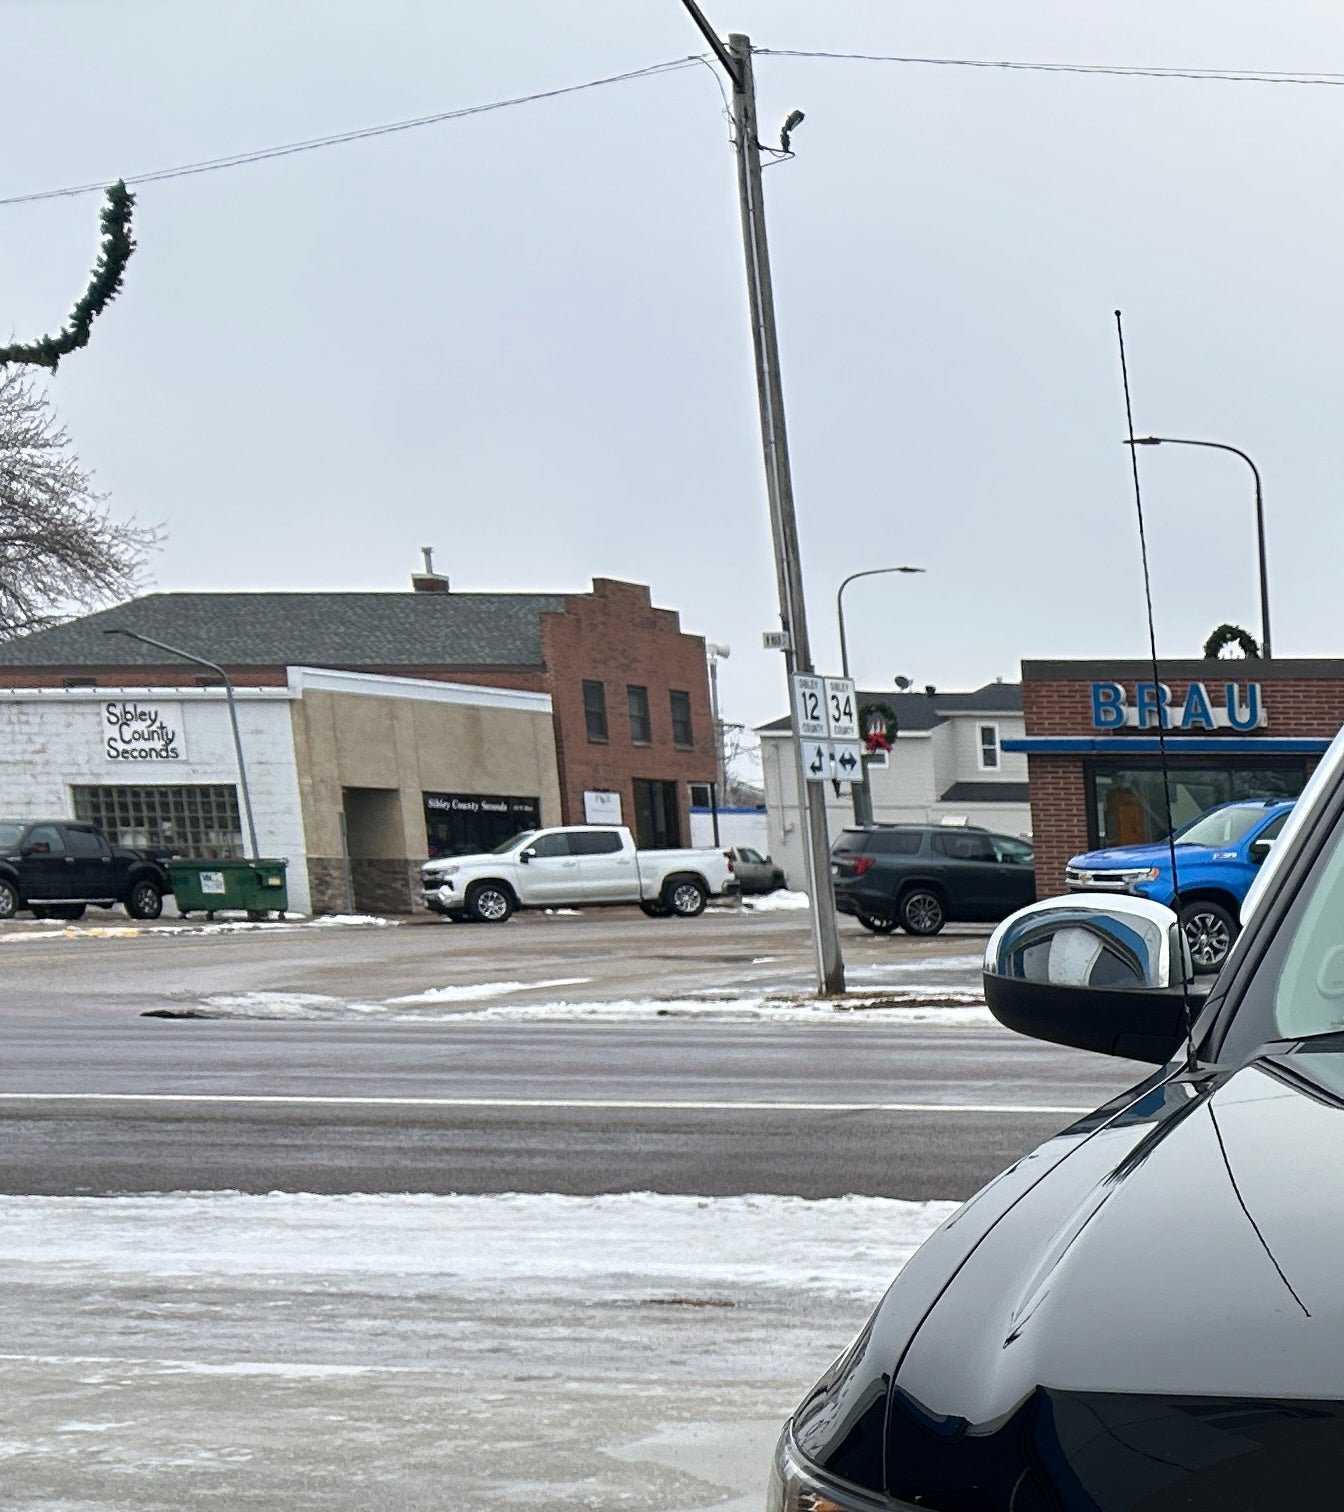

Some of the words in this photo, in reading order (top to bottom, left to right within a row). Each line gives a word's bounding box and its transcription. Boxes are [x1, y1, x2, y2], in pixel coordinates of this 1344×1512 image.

[106, 703, 158, 729] Sibley
[802, 691, 820, 720] 12
[831, 695, 853, 724] 34
[1091, 682, 1261, 730] BRAU
[118, 721, 175, 747] County
[106, 737, 179, 759] Seconds
